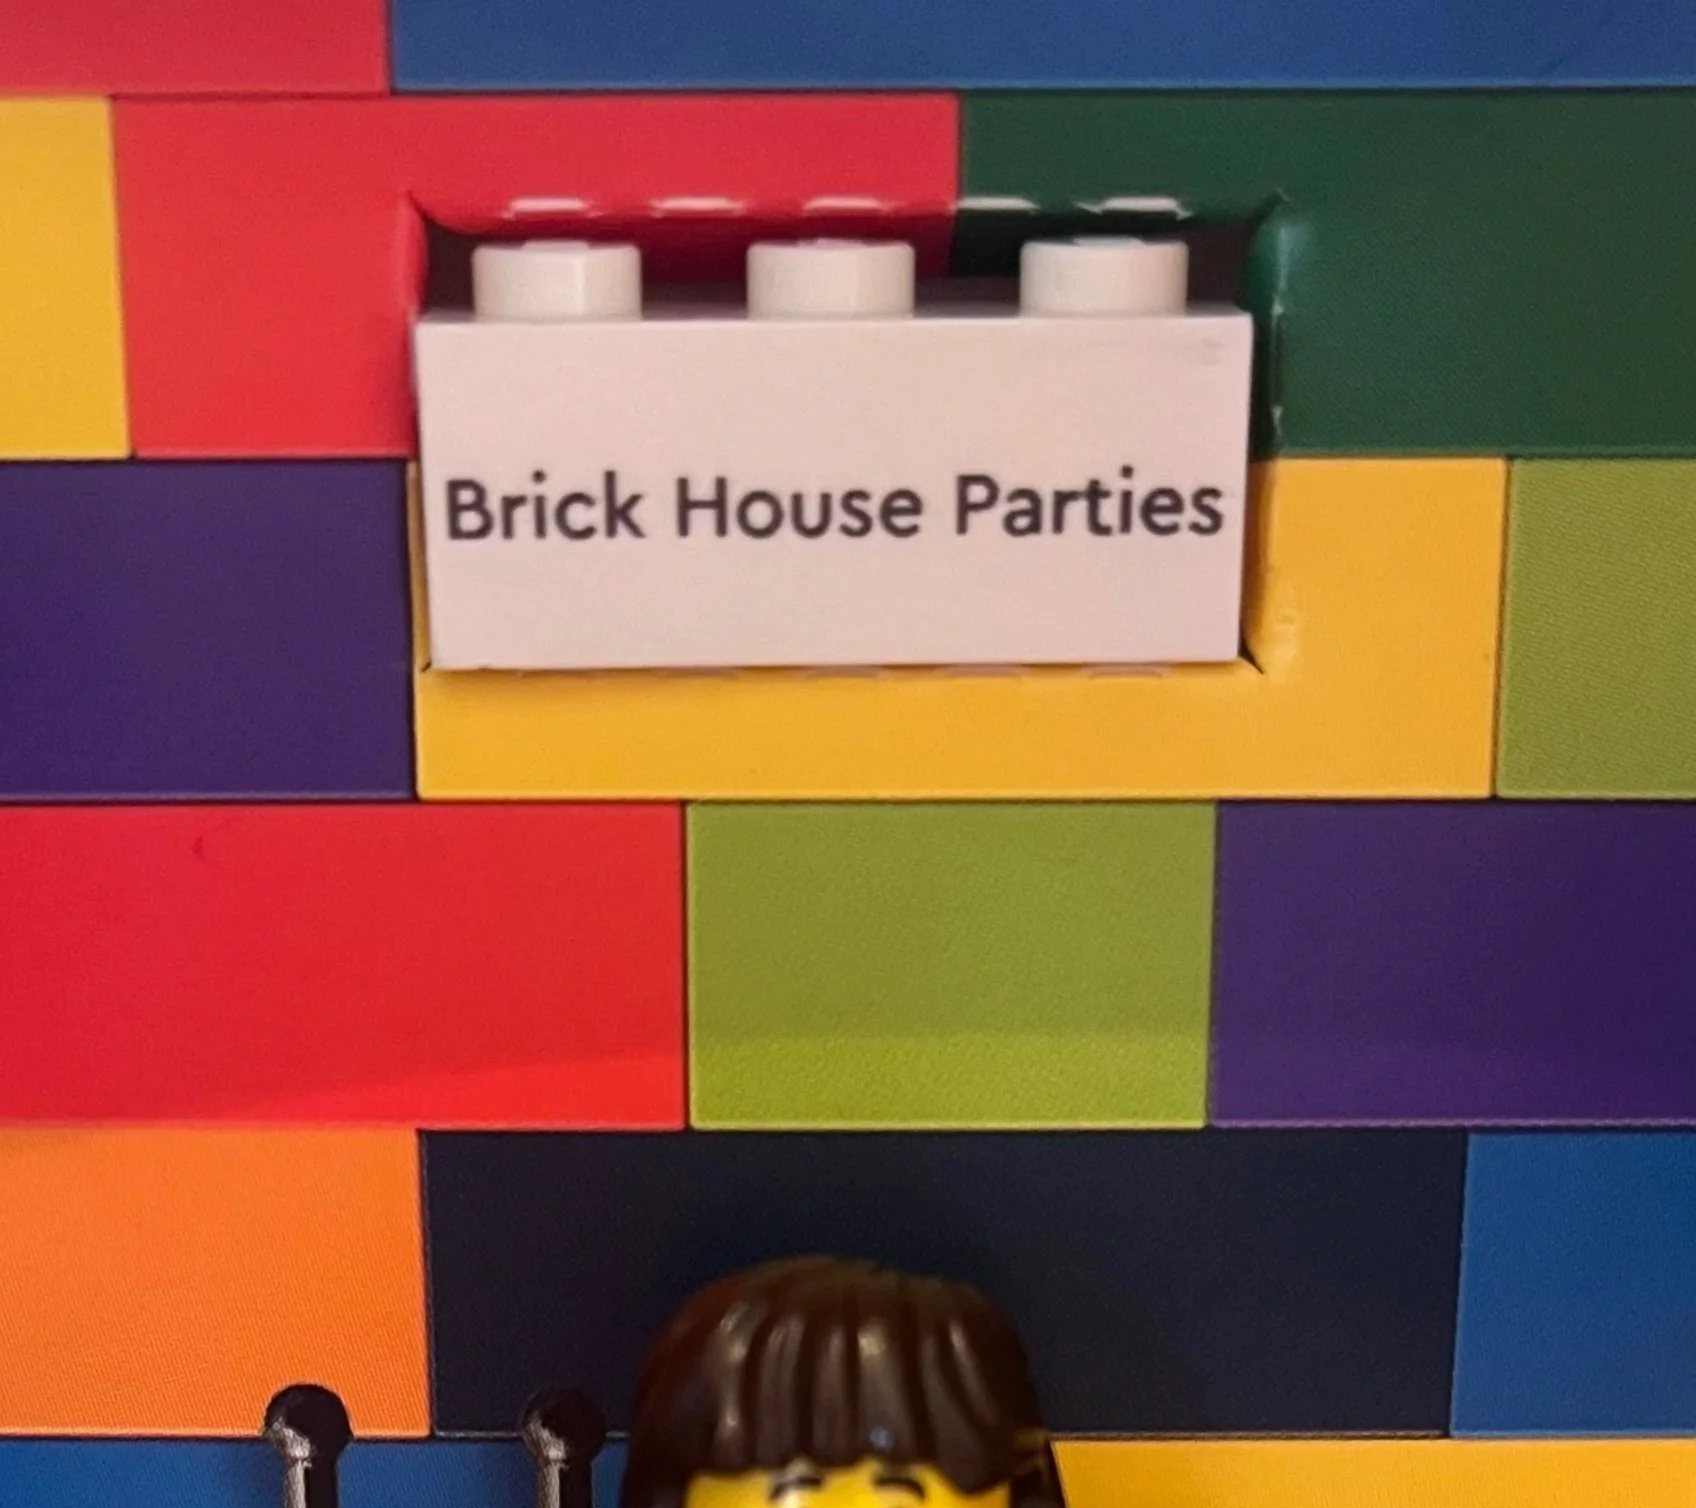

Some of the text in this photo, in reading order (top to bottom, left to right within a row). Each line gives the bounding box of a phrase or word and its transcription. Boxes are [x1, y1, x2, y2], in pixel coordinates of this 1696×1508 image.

[444, 464, 1225, 541] Brick House Parties
